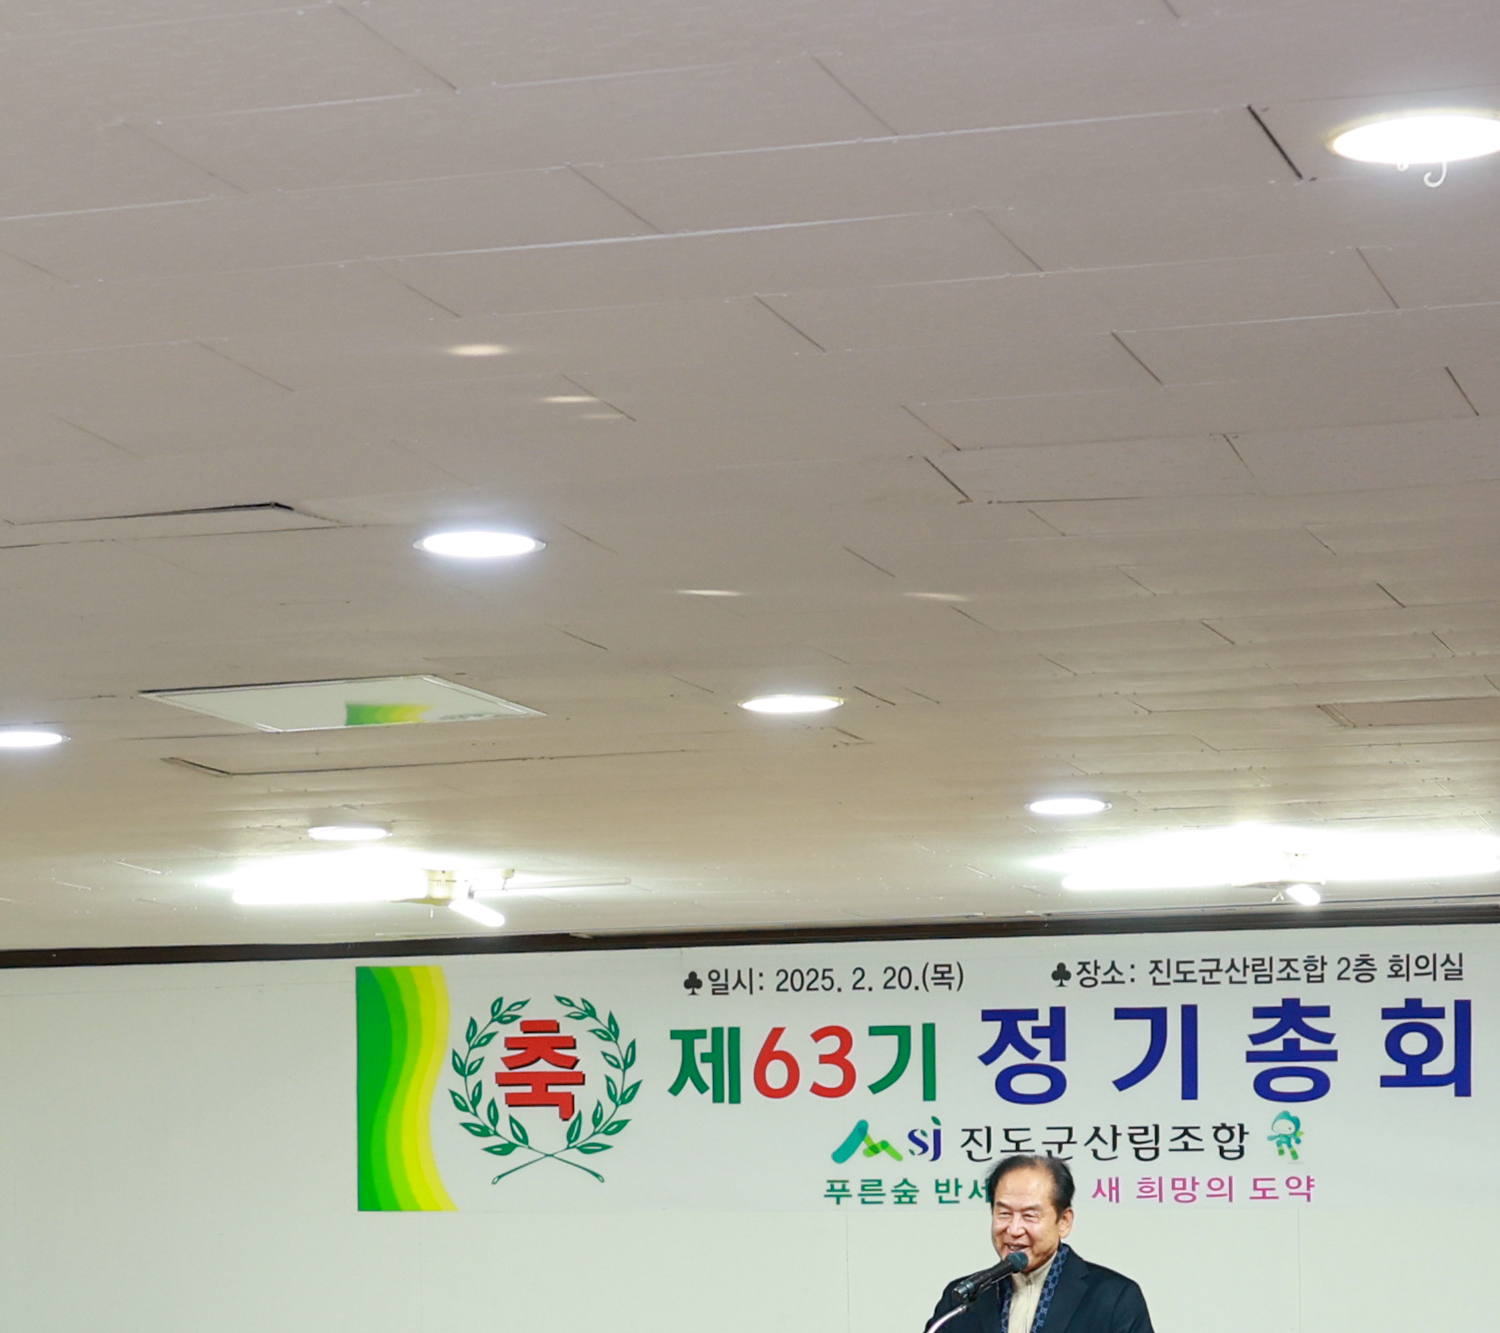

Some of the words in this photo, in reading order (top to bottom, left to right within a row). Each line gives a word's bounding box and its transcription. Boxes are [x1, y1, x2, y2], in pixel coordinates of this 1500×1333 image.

[707, 968, 766, 996] 일시:
[775, 966, 843, 993] 2025.
[852, 966, 874, 992] 2.
[881, 963, 964, 992] 20.(목)
[1076, 959, 1136, 988] 장소:
[1148, 953, 1328, 987] 진도군산림조합
[1337, 953, 1379, 984] 2층
[1387, 952, 1465, 984] 회의실
[496, 1019, 586, 1122] 축
[668, 1022, 938, 1105] 제63기
[960, 1120, 1250, 1163] 진도군산림조합
[823, 1175, 921, 1205] 푸른숲
[1092, 1175, 1121, 1204] 새
[1136, 1175, 1236, 1204] 희망의
[1249, 1173, 1317, 1204] 도약
